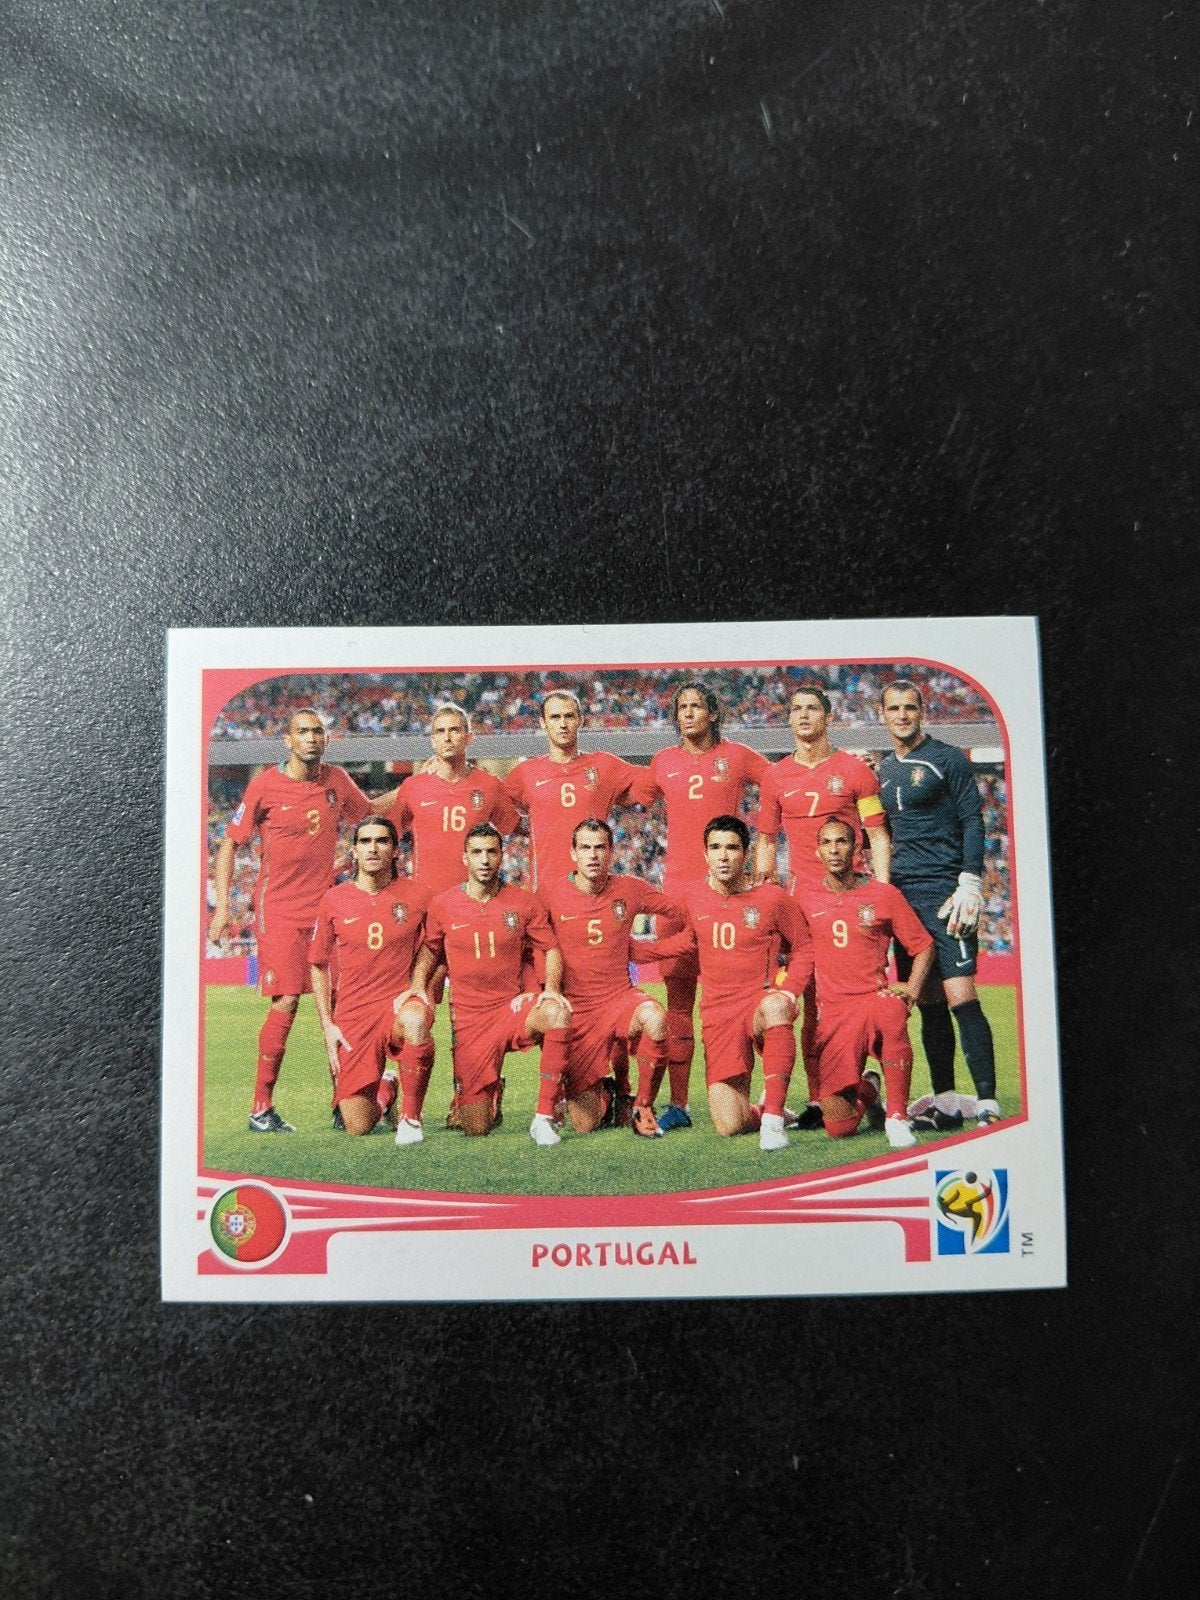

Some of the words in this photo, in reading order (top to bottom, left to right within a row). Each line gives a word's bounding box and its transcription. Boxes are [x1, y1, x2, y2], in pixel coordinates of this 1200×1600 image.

[561, 783, 575, 807] 6
[688, 775, 704, 800] 2
[896, 786, 902, 811] 1
[805, 791, 820, 817] 7
[306, 809, 322, 835] 3
[442, 805, 466, 832] 16
[367, 922, 384, 951] 8
[473, 931, 496, 959] 11
[588, 919, 603, 945] 5
[712, 921, 735, 950] 10
[832, 919, 848, 948] 9
[531, 1241, 697, 1268] PORTUGAL
[1021, 1232, 1034, 1258] TM
